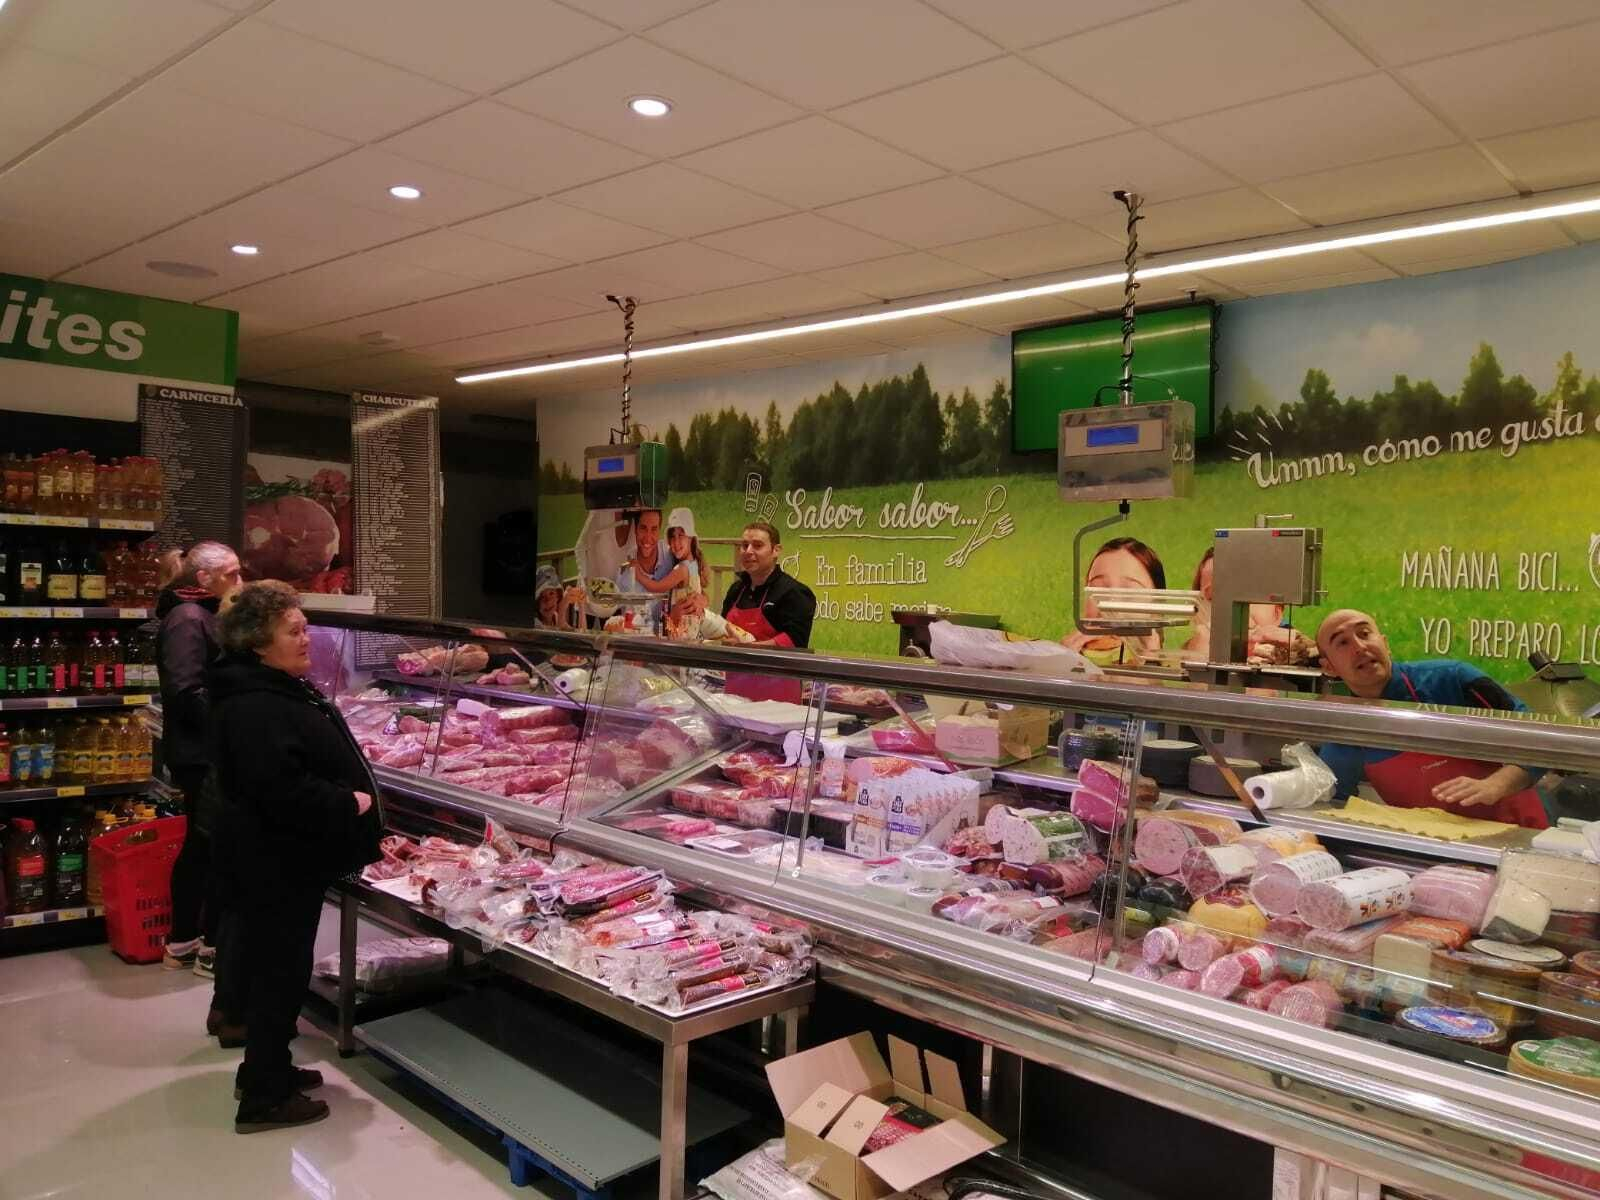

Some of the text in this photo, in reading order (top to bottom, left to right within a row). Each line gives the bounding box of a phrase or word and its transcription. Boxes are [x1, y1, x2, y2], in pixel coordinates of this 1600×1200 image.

[1363, 437, 1441, 467] cómo
[1450, 427, 1493, 451] me
[1500, 400, 1583, 457] gusta
[785, 482, 978, 529] Sabor sabor...
[816, 553, 928, 585] En familia
[1401, 546, 1579, 592] MAÑANA BICI...
[845, 593, 884, 623] sabe
[1421, 617, 1450, 655] YO
[1469, 618, 1562, 662] PREPARO
